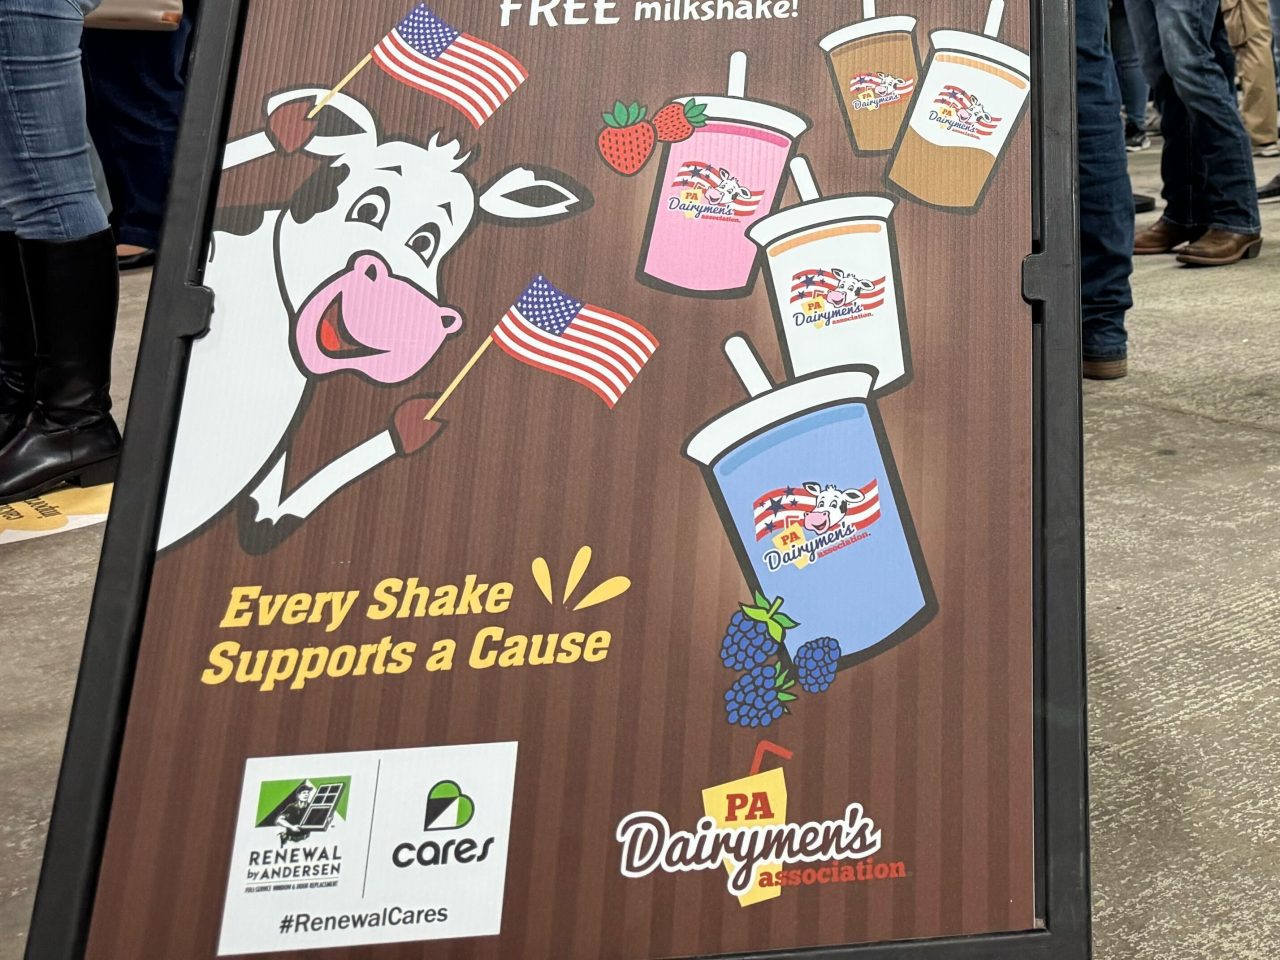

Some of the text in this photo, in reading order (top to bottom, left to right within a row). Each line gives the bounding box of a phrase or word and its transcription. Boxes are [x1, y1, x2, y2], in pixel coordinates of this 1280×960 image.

[852, 93, 900, 110] Dairymen's
[929, 110, 976, 131] Dairymen's
[669, 197, 733, 218] Dairymen's
[685, 192, 699, 201] PA
[793, 302, 863, 326] Dairymen's
[807, 301, 822, 311] PA
[763, 521, 856, 571] Dairymen's
[780, 531, 801, 546] PA
[219, 574, 514, 632] Every Shake
[200, 626, 612, 691] Supports a Cause
[724, 791, 774, 822] PA
[249, 845, 342, 866] RENEWAL
[392, 837, 495, 868] cares
[617, 803, 882, 896] Dairymen's
[246, 862, 341, 881] by ANDERSEN
[279, 906, 448, 934] #RenewalCares
